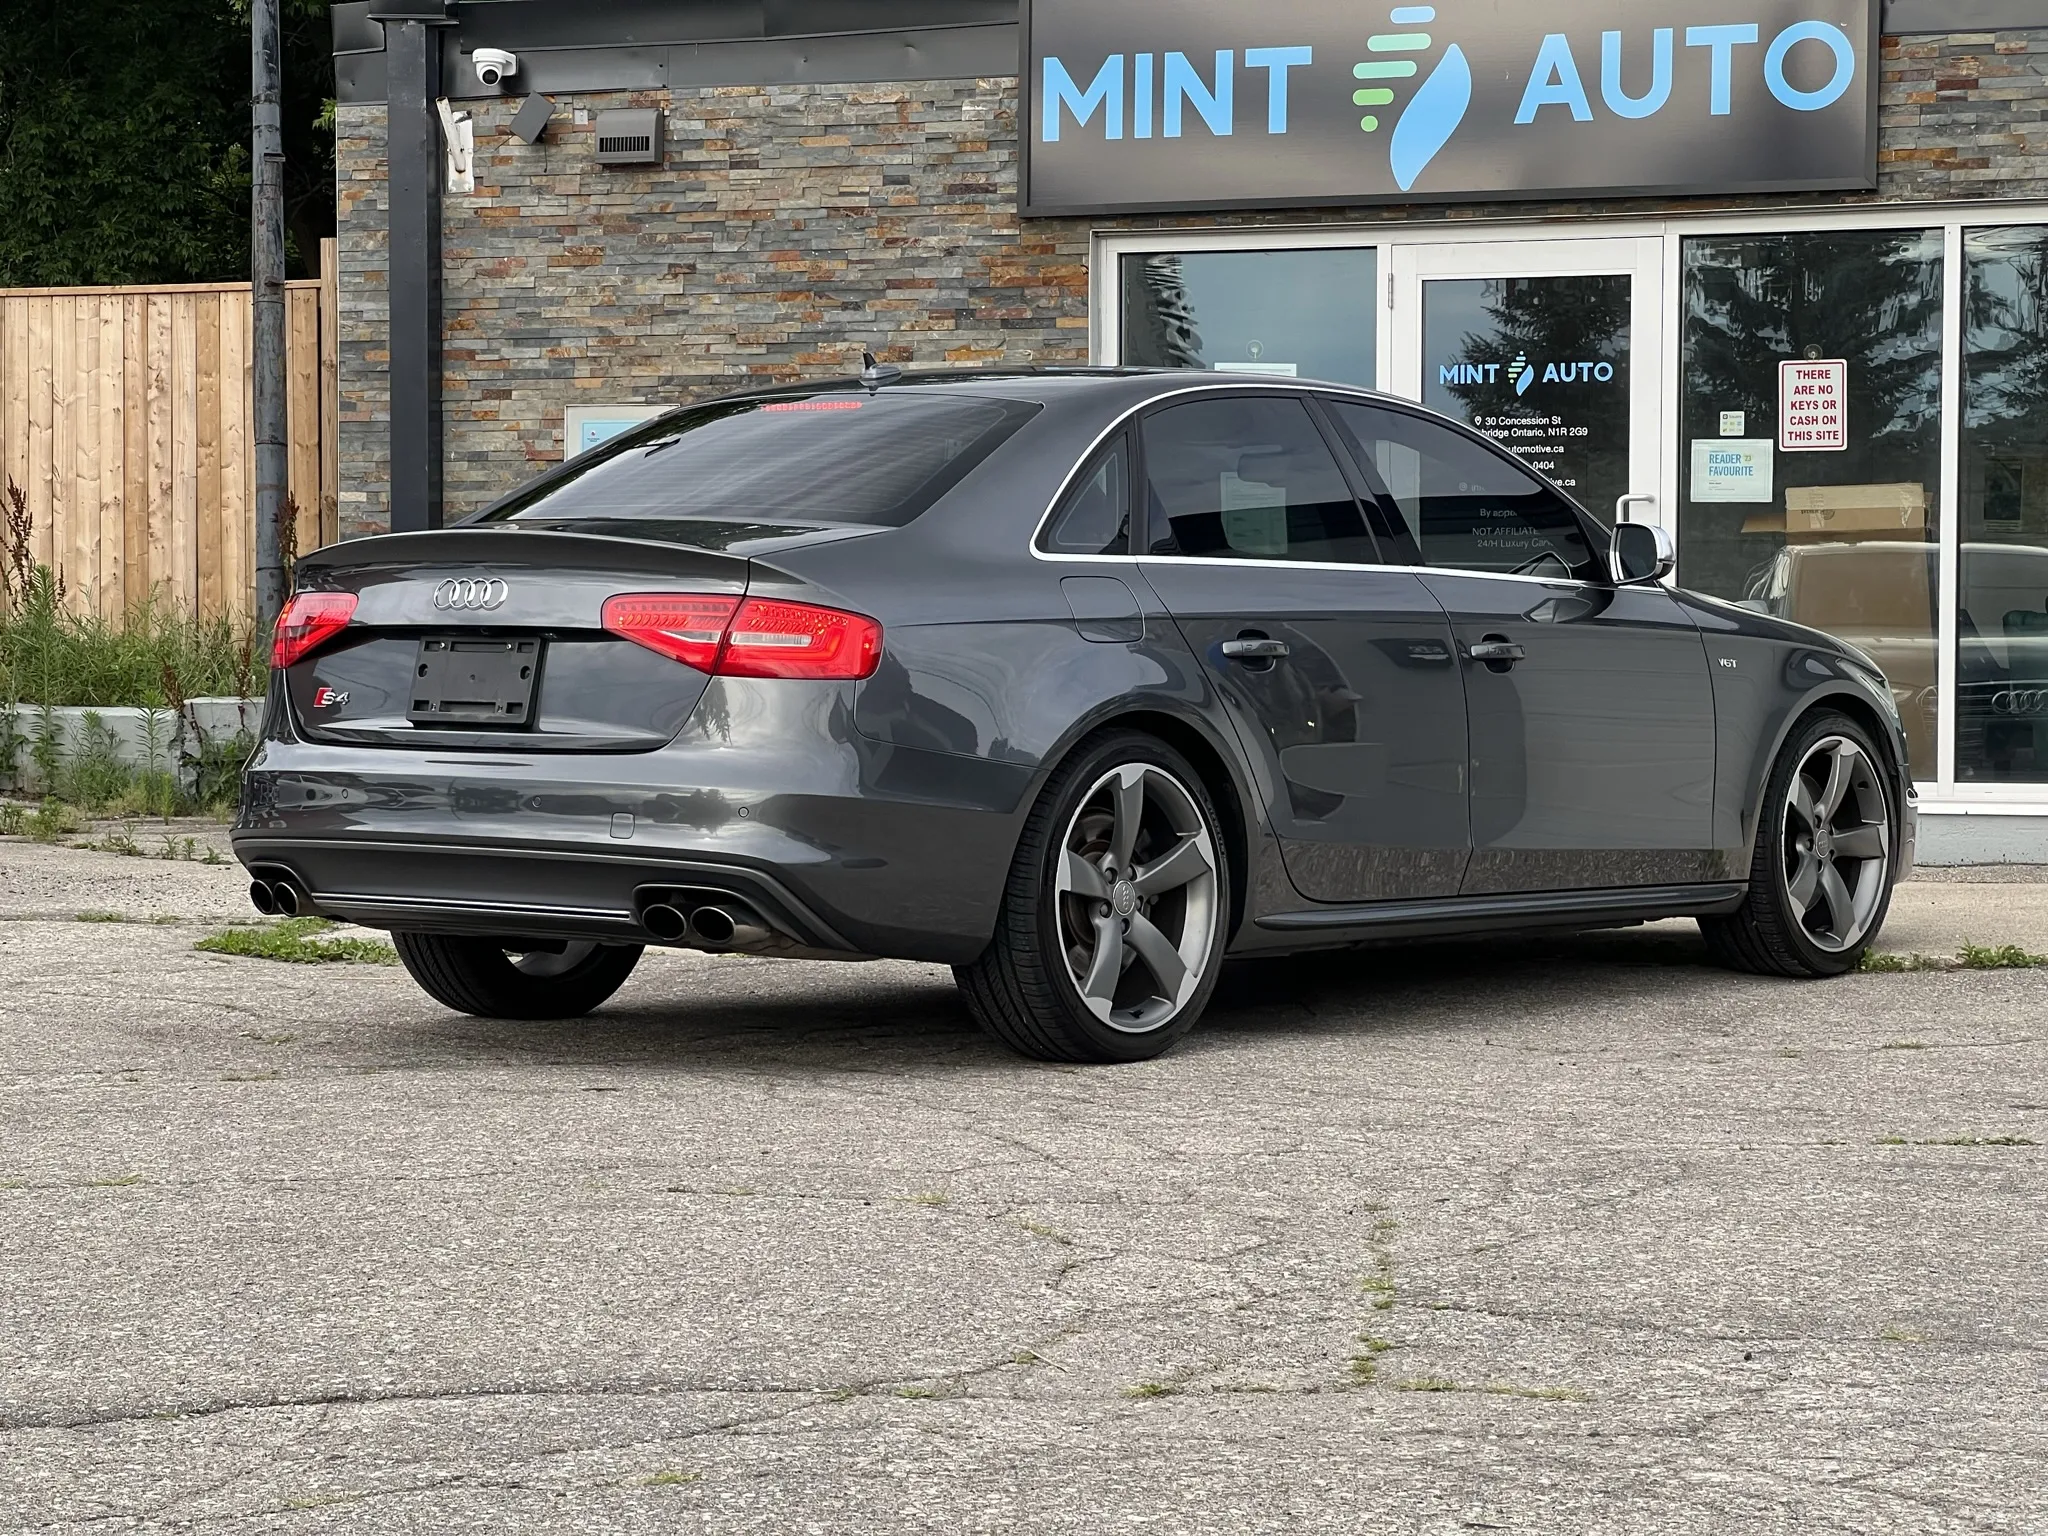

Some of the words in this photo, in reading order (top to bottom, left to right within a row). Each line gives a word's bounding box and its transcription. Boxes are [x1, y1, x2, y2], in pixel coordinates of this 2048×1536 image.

[1043, 46, 1312, 142] MINT
[1514, 20, 1855, 125] AUTO
[1439, 364, 1500, 385] MINT
[1542, 361, 1613, 383] AUTO
[1796, 369, 1831, 380] THERE
[1793, 385, 1815, 395] ARE
[1818, 385, 1833, 395] NO
[1790, 400, 1819, 411] KEYS
[1822, 400, 1837, 410] OR
[1485, 417, 1496, 426] 30
[1498, 416, 1550, 426] Concession
[1551, 415, 1561, 425] St
[1789, 415, 1819, 426] CASH
[1822, 415, 1837, 425] ON
[1511, 428, 1546, 437] Ontario,
[1548, 427, 1567, 436] N1R
[1569, 427, 1588, 436] 2G9
[1787, 431, 1813, 441] THIS
[1815, 430, 1839, 440] SITE
[1709, 454, 1741, 464] READER
[1709, 466, 1753, 477] FAVOURITE
[1472, 527, 1492, 536] NOT
[1500, 539, 1529, 549] Luxury
[1718, 657, 1737, 668] V6T
[321, 691, 350, 706] S4
